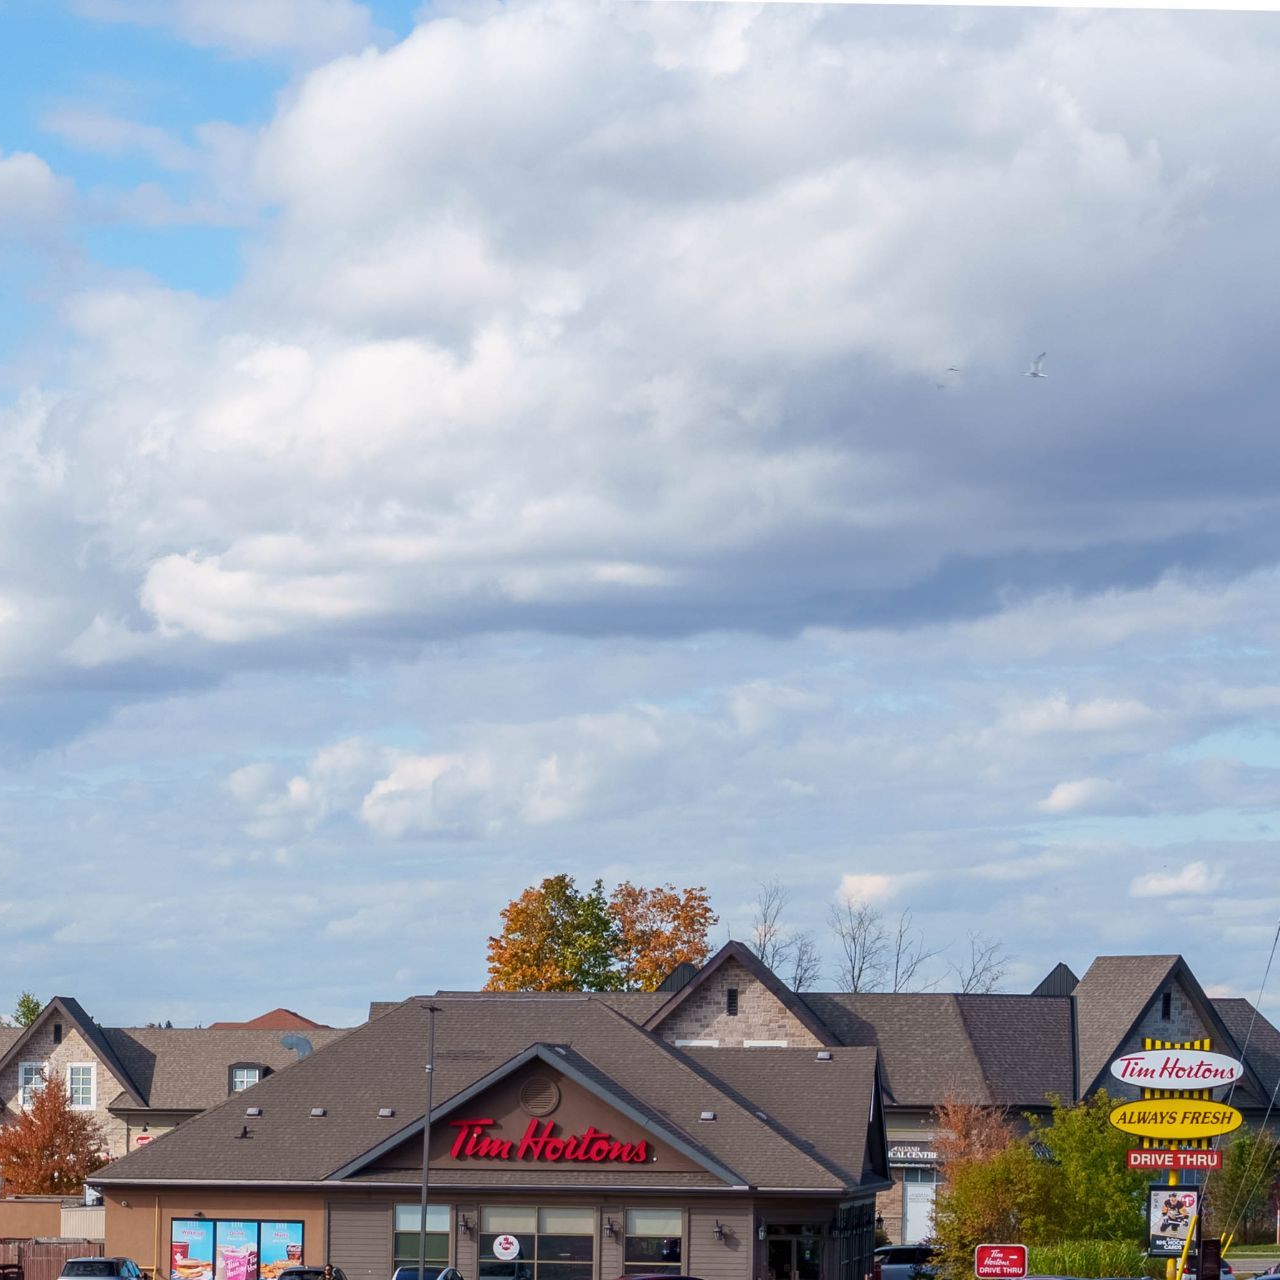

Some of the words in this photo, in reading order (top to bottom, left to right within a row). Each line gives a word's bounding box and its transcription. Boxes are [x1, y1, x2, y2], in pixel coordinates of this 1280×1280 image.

[1120, 1057, 1156, 1078] Tim
[1159, 1057, 1235, 1079] Hortons
[1116, 1111, 1177, 1125] ALWAYS
[1180, 1111, 1233, 1125] FRESH
[448, 1118, 514, 1160] Tim
[516, 1118, 647, 1162] Hortons
[907, 1151, 938, 1159] CENTRE
[1130, 1153, 1174, 1166] DRIVE
[1177, 1153, 1218, 1166] THRU
[991, 1250, 1003, 1258] Tim
[984, 1257, 1010, 1266] Hortons
[979, 1266, 1001, 1274] DRIVE
[1002, 1266, 1023, 1274] THRU
